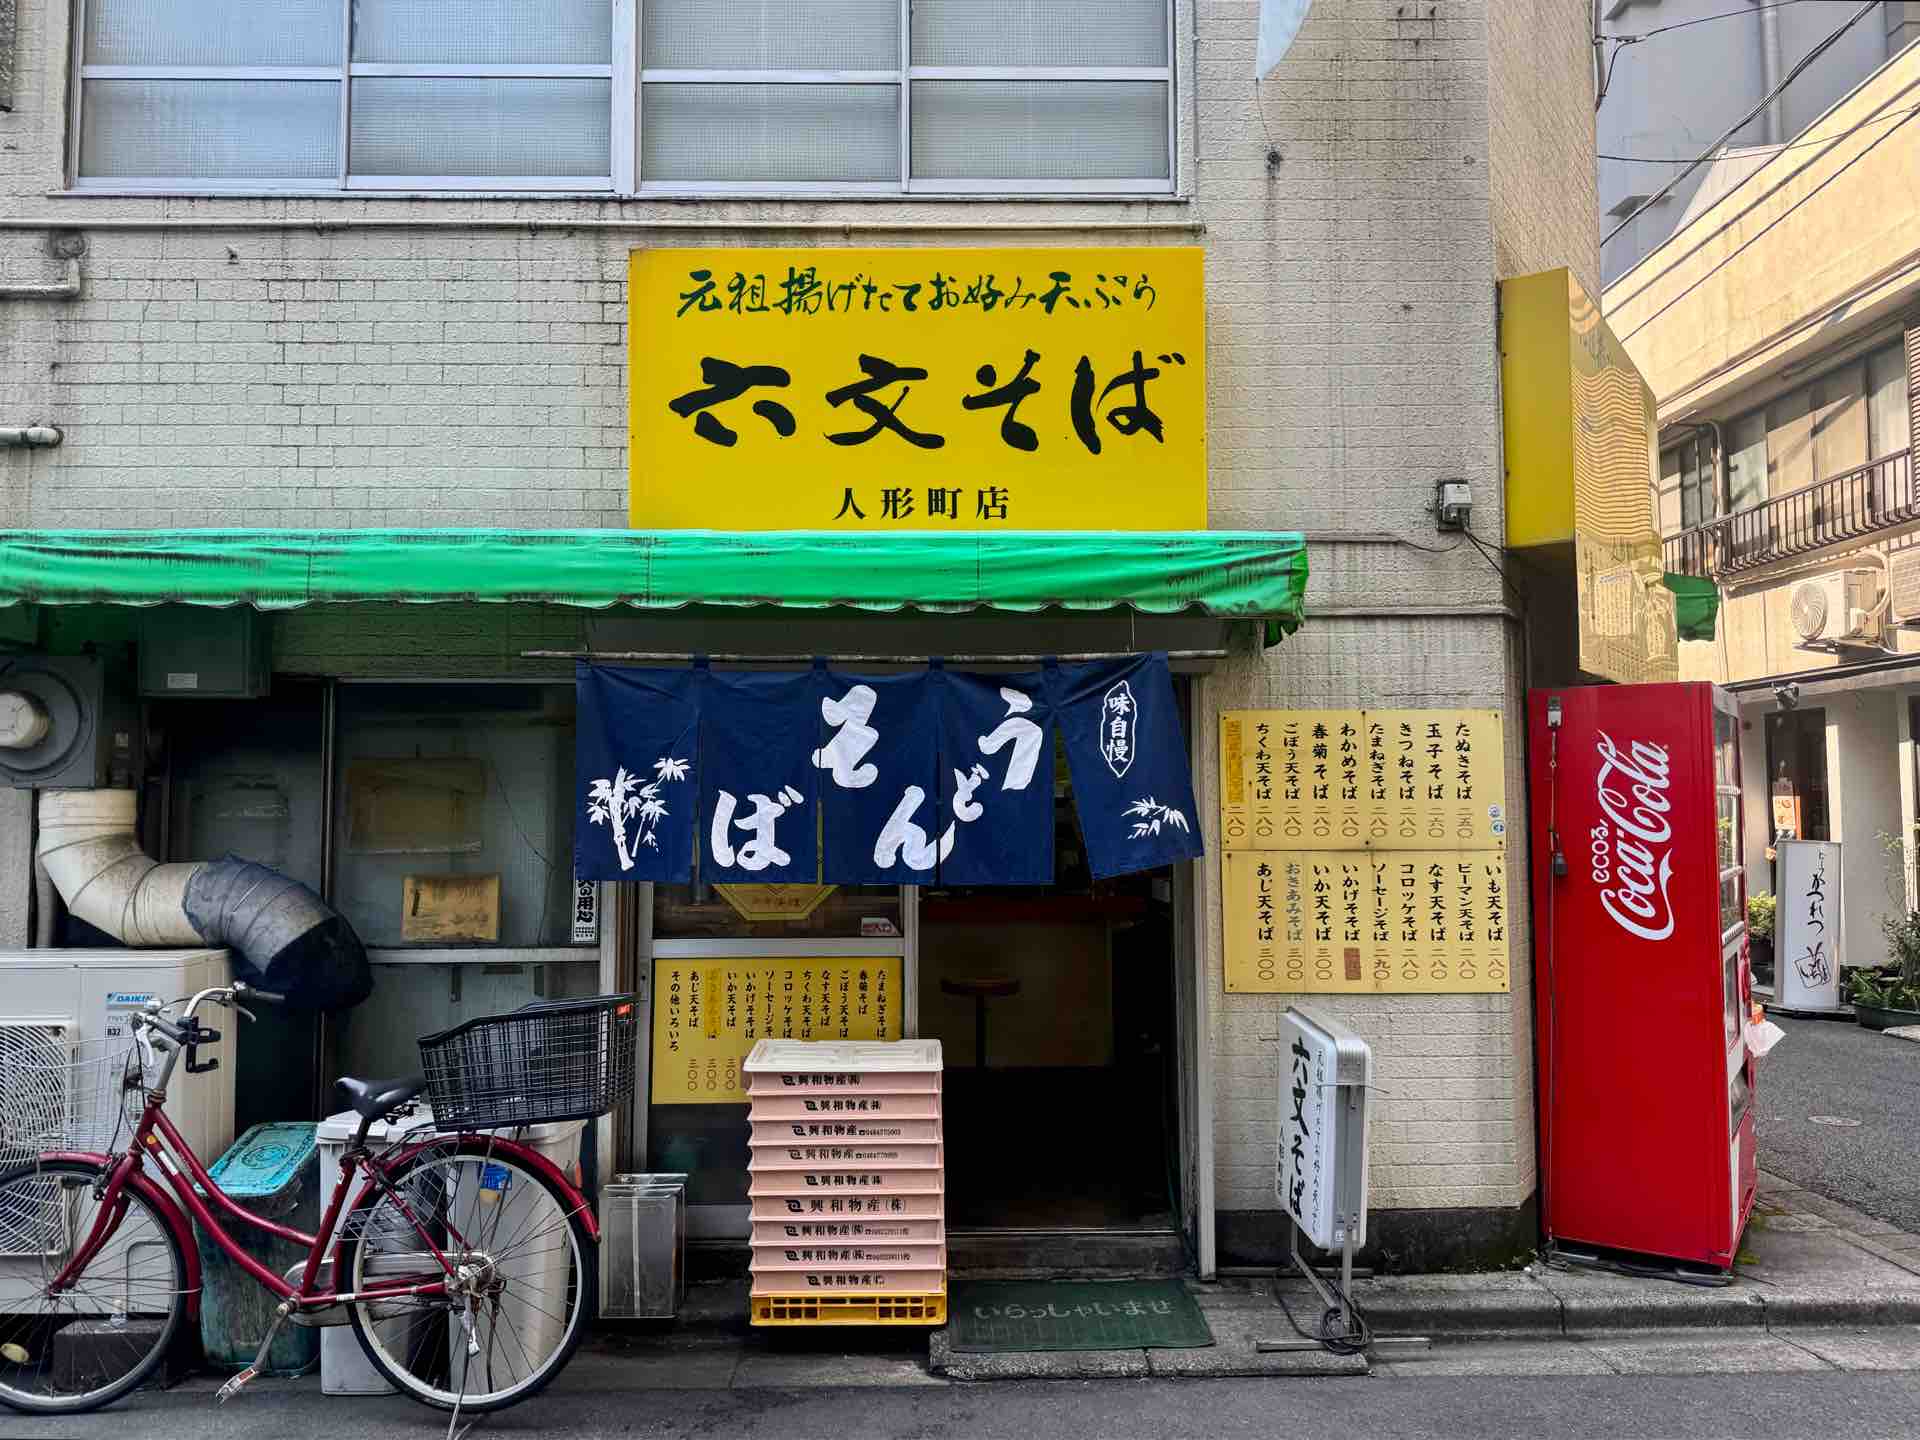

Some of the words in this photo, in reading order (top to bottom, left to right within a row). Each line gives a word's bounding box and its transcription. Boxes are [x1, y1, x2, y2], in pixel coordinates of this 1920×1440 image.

[676, 266, 1157, 316] 元祖揚げたてお好み天ぷら
[668, 349, 1186, 455] 六文そば
[833, 486, 1010, 521] 人形町店
[1106, 692, 1130, 764] 味自慢
[1255, 722, 1272, 800] ちくわ天そば
[1283, 722, 1301, 800] ごぼう天そば
[1311, 722, 1329, 800] 春菊そば
[1340, 722, 1358, 800] わかめそば
[1369, 722, 1386, 800] たまねぎそば
[1398, 722, 1415, 800] きつねそば
[1425, 722, 1444, 800] 玉子そば
[1455, 722, 1472, 800] たぬきそば
[711, 684, 880, 871] そば
[874, 686, 1044, 871] うどん
[1257, 862, 1275, 941] あじ天そば
[1285, 862, 1303, 941] おきあみそば
[1313, 864, 1331, 941] いか天そば
[1342, 864, 1361, 941] いかげそそば
[1371, 862, 1389, 941] ソーセージそば
[1400, 863, 1417, 941] コロッケそば
[1428, 863, 1446, 941] なす天そば
[1457, 863, 1475, 941] ピーマン天そば
[1485, 864, 1504, 941] いも天そば
[669, 970, 681, 1053] その他いろいろ
[688, 970, 699, 1028] あじ天そば
[726, 970, 737, 1028] いか天そば
[783, 970, 793, 1038] コロッケそば
[1290, 1037, 1310, 1219] 六文そば
[974, 1298, 1172, 1320] いらっしゃいませ
